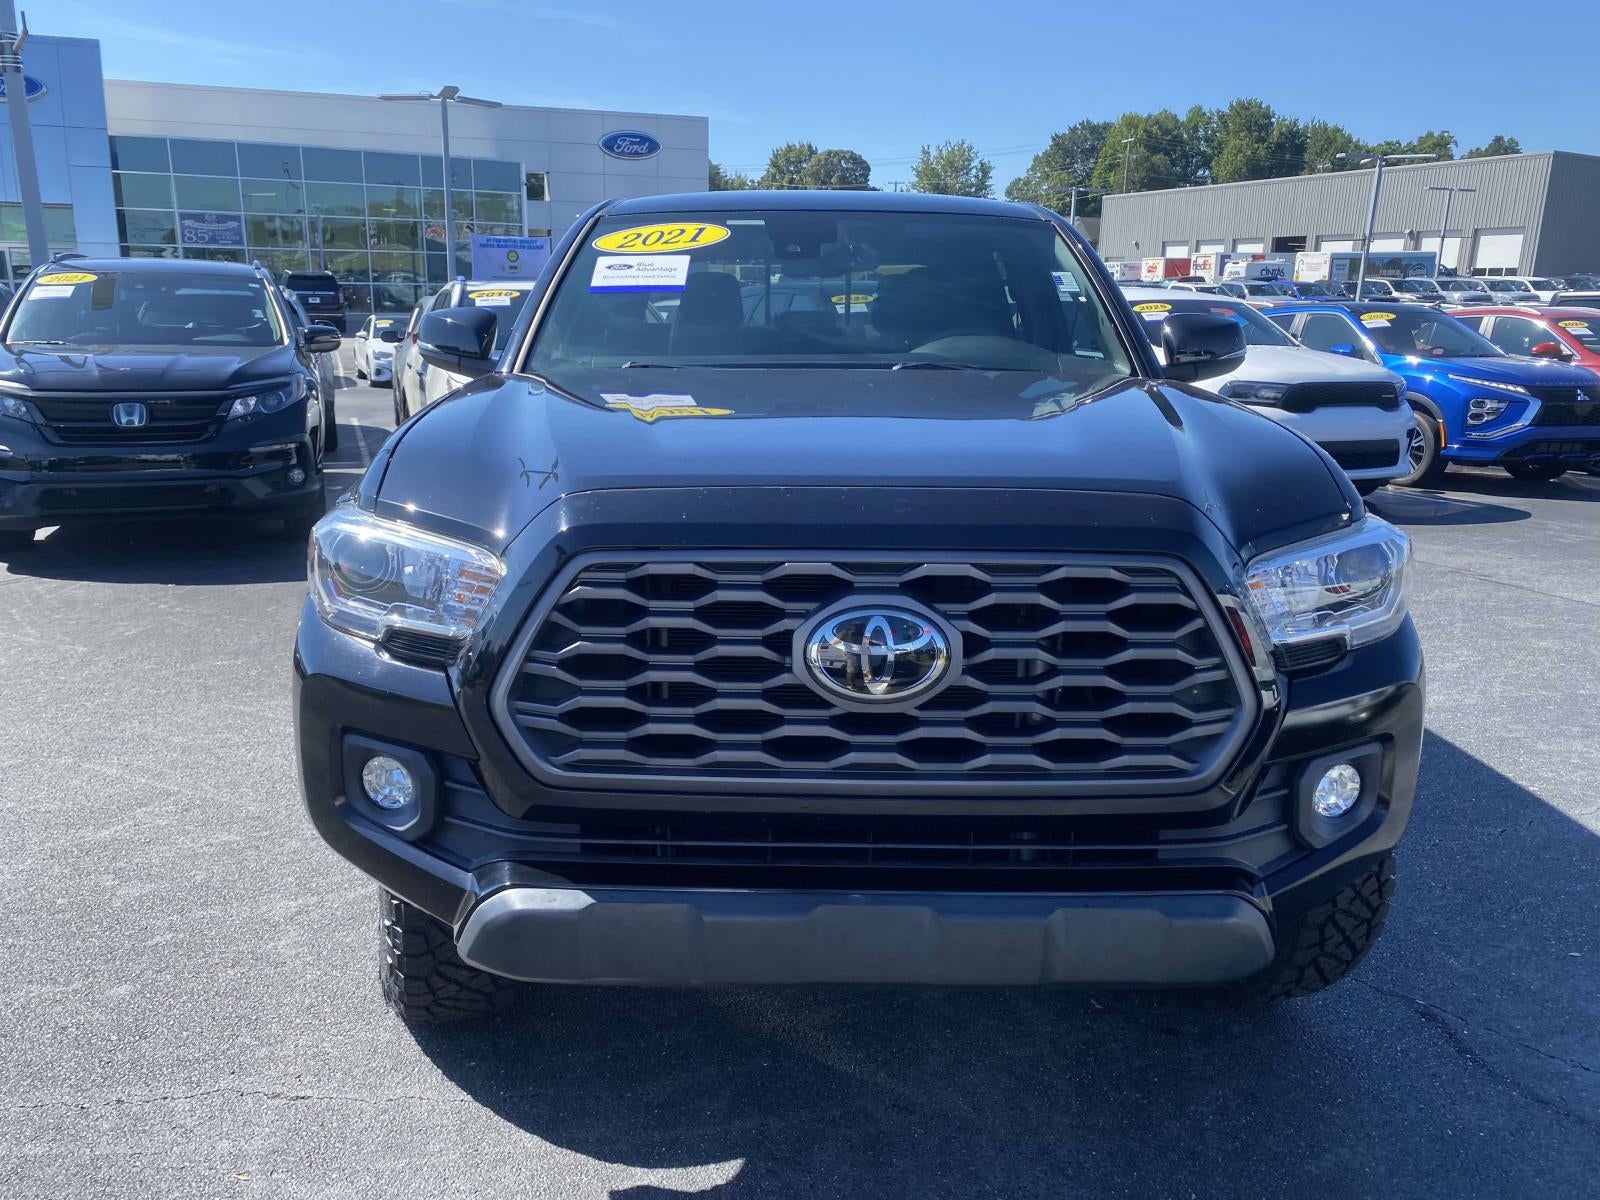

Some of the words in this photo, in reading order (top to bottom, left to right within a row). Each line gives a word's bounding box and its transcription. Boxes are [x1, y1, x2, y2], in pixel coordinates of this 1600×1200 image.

[614, 136, 649, 154] Ford
[616, 227, 707, 249] 2021
[1192, 260, 1212, 271] FedEx
[47, 274, 88, 282] 2021
